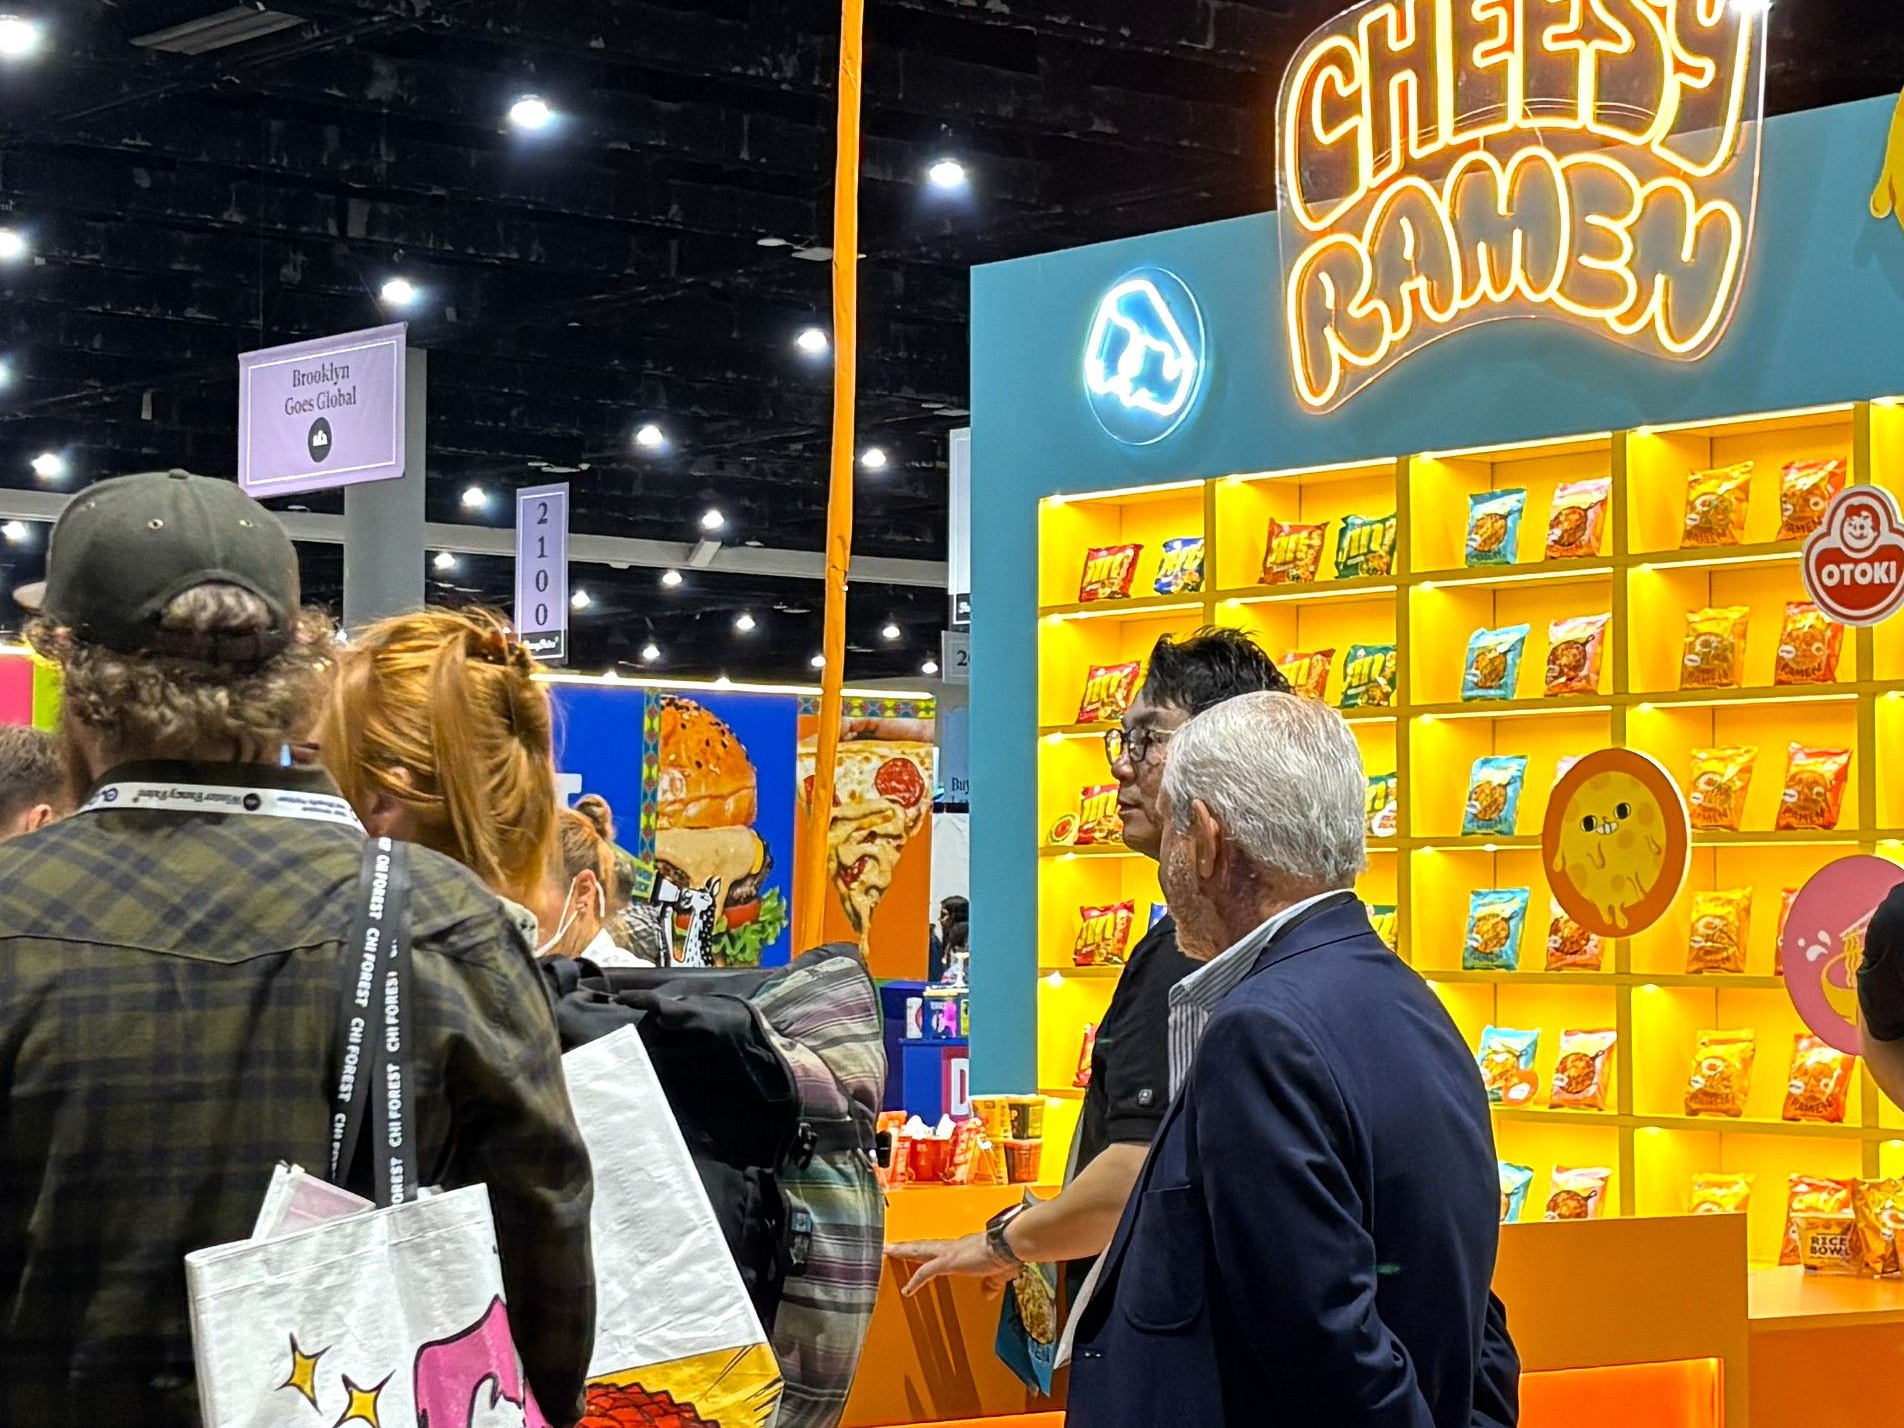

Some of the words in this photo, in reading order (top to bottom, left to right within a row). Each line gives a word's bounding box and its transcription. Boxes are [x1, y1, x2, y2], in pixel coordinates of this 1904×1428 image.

[1286, 145, 1743, 412] RAMEN
[292, 361, 350, 388] Brooklyn
[284, 397, 315, 416] Goes
[316, 385, 357, 410] Global
[534, 501, 549, 627] 2100
[1821, 559, 1897, 589] OTOKI
[363, 927, 380, 952] CHI
[354, 952, 377, 1008] FOREST
[349, 1017, 365, 1044] CHI
[384, 1026, 400, 1053] CHI
[338, 1045, 361, 1103] FOREST
[386, 1062, 402, 1120] FOREST
[388, 1121, 403, 1148] CHI
[390, 1156, 405, 1205] OREST
